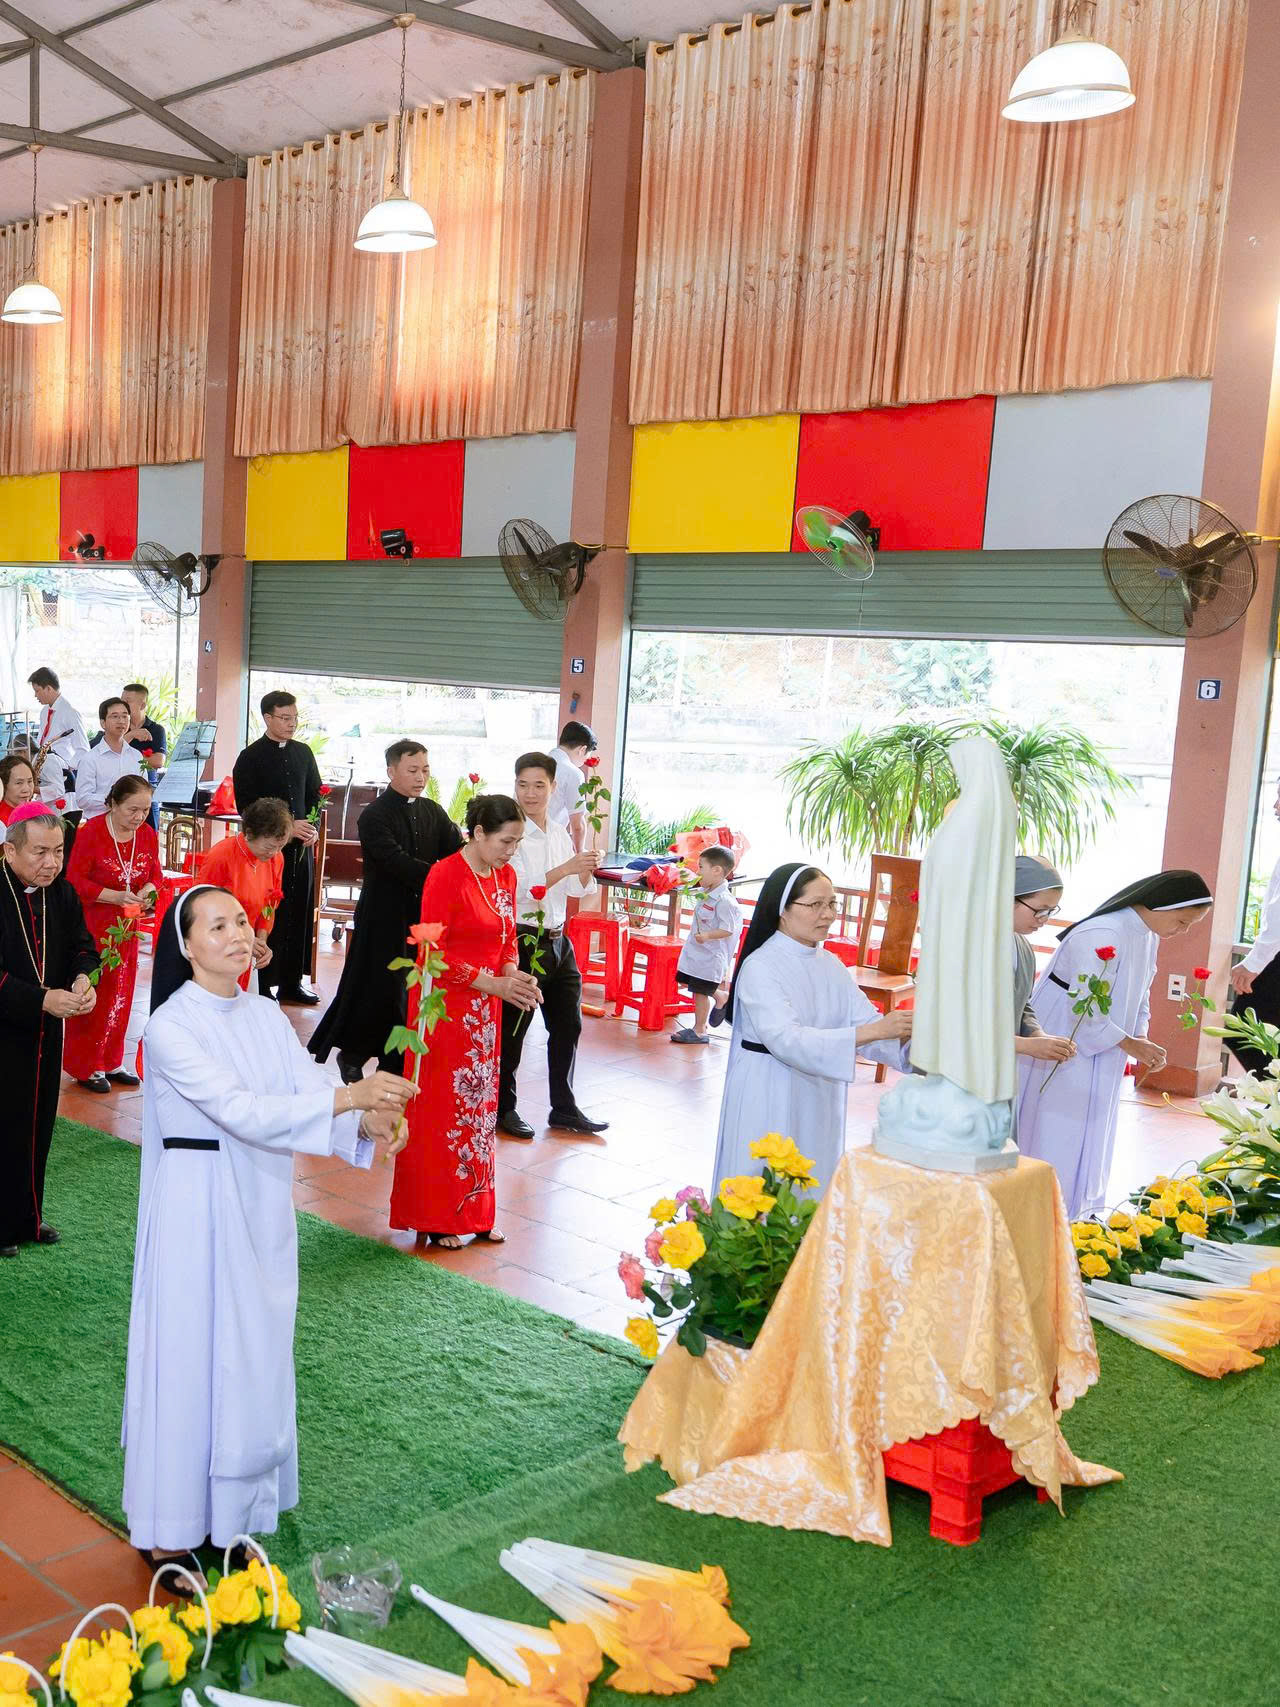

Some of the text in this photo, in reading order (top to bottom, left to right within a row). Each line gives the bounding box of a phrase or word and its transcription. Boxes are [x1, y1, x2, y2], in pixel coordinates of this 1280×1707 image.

[205, 640, 212, 652] 4
[573, 659, 583, 673] 5
[1200, 681, 1217, 699] 6
